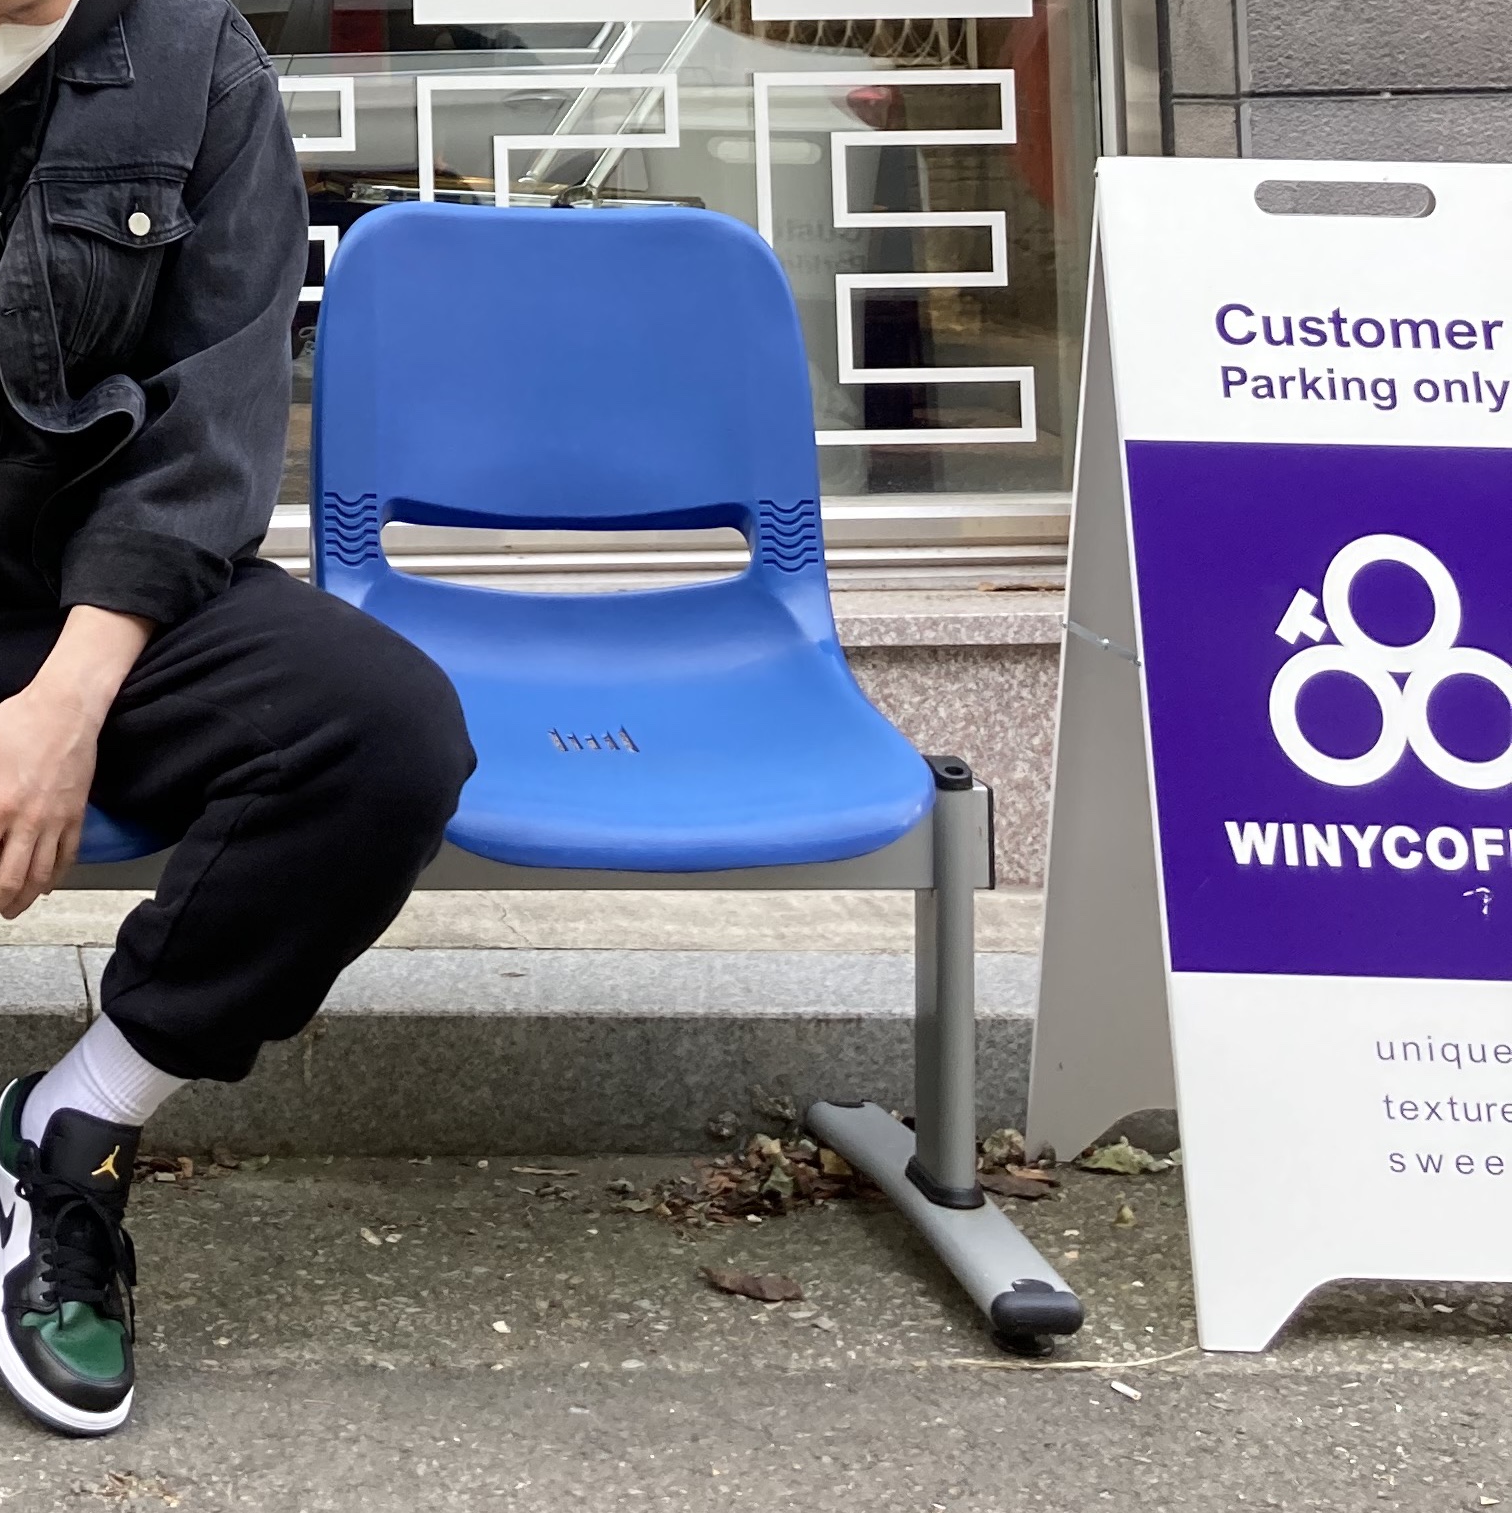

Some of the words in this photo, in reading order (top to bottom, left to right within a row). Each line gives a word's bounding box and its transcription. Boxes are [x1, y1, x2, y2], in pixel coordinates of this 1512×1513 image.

[1215, 303, 1504, 351] Customer
[1220, 366, 1398, 411] Parking
[1413, 370, 1511, 413] only
[1225, 821, 1512, 872] WINYCOF
[1376, 1035, 1512, 1070] unique
[1383, 1094, 1512, 1123] texture
[1389, 1152, 1504, 1175] swee
